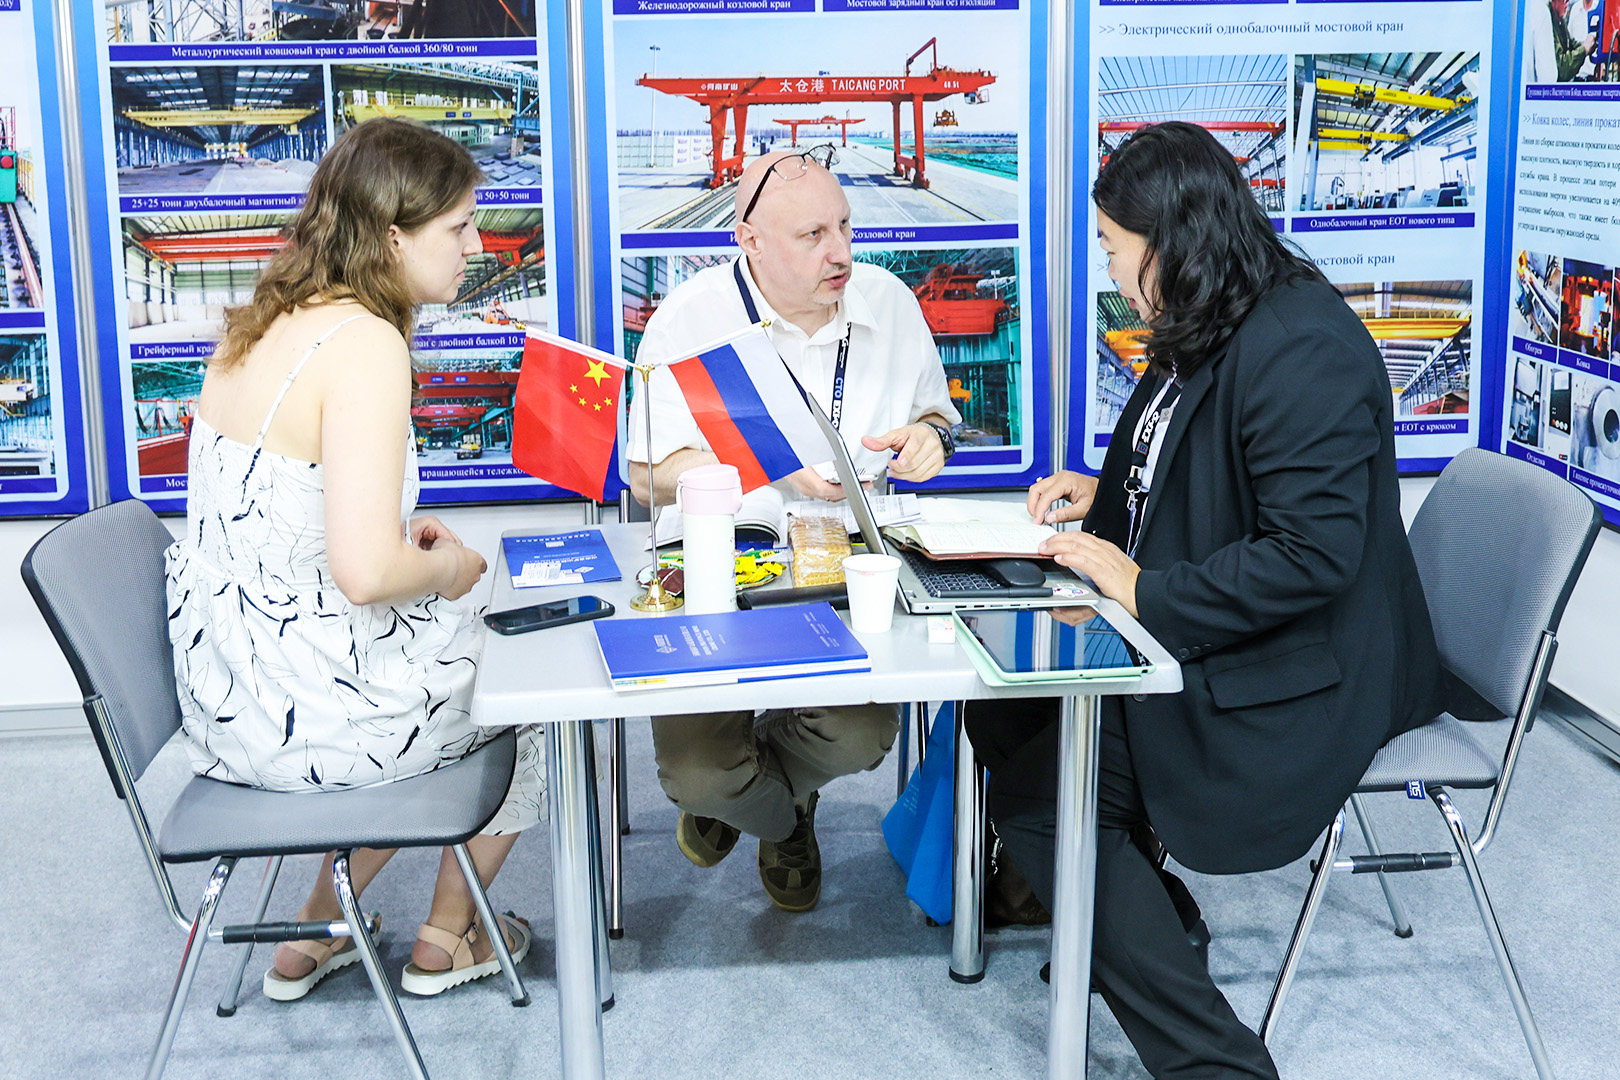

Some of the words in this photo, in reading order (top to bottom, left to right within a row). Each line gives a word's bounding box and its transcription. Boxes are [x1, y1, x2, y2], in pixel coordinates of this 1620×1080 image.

[638, 1, 724, 11] Железнодорожный
[727, 1, 767, 9] козловой
[770, 1, 790, 10] кран
[927, 0, 944, 8] кран
[1119, 22, 1212, 36] Электрический
[1216, 21, 1310, 34] однобалочный
[1315, 21, 1372, 33] мостовой
[1376, 22, 1403, 34] кран
[172, 46, 261, 58] Металлургический
[264, 45, 312, 56] ковшовый
[315, 46, 336, 57] кран
[339, 46, 344, 54] с
[347, 44, 385, 56] двойной
[388, 44, 420, 54] балкой
[423, 43, 453, 54] 360/80
[456, 44, 478, 54] тонн
[780, 79, 824, 93] 太仓港
[832, 79, 876, 91] TAICANG
[879, 79, 905, 91] PORT
[1532, 113, 1550, 125] Ковка
[1572, 117, 1593, 127] линия
[485, 191, 509, 200] 50+50
[131, 198, 159, 208] 25+25
[160, 198, 182, 208] тонн
[184, 196, 246, 210] двухбалочный
[248, 196, 297, 207] магнитный
[1310, 218, 1367, 228] Однобалочный
[1369, 219, 1387, 227] кран
[1409, 217, 1435, 225] нового
[852, 229, 893, 239] Козловой
[895, 230, 916, 240] кран
[1368, 254, 1395, 266] кран
[438, 338, 473, 347] двойной
[476, 336, 505, 345] балкой
[509, 336, 517, 345] 10
[138, 345, 194, 356] Грейферный
[834, 377, 844, 398] CTO
[1427, 423, 1456, 432] крюком
[422, 468, 483, 479] вращающейся
